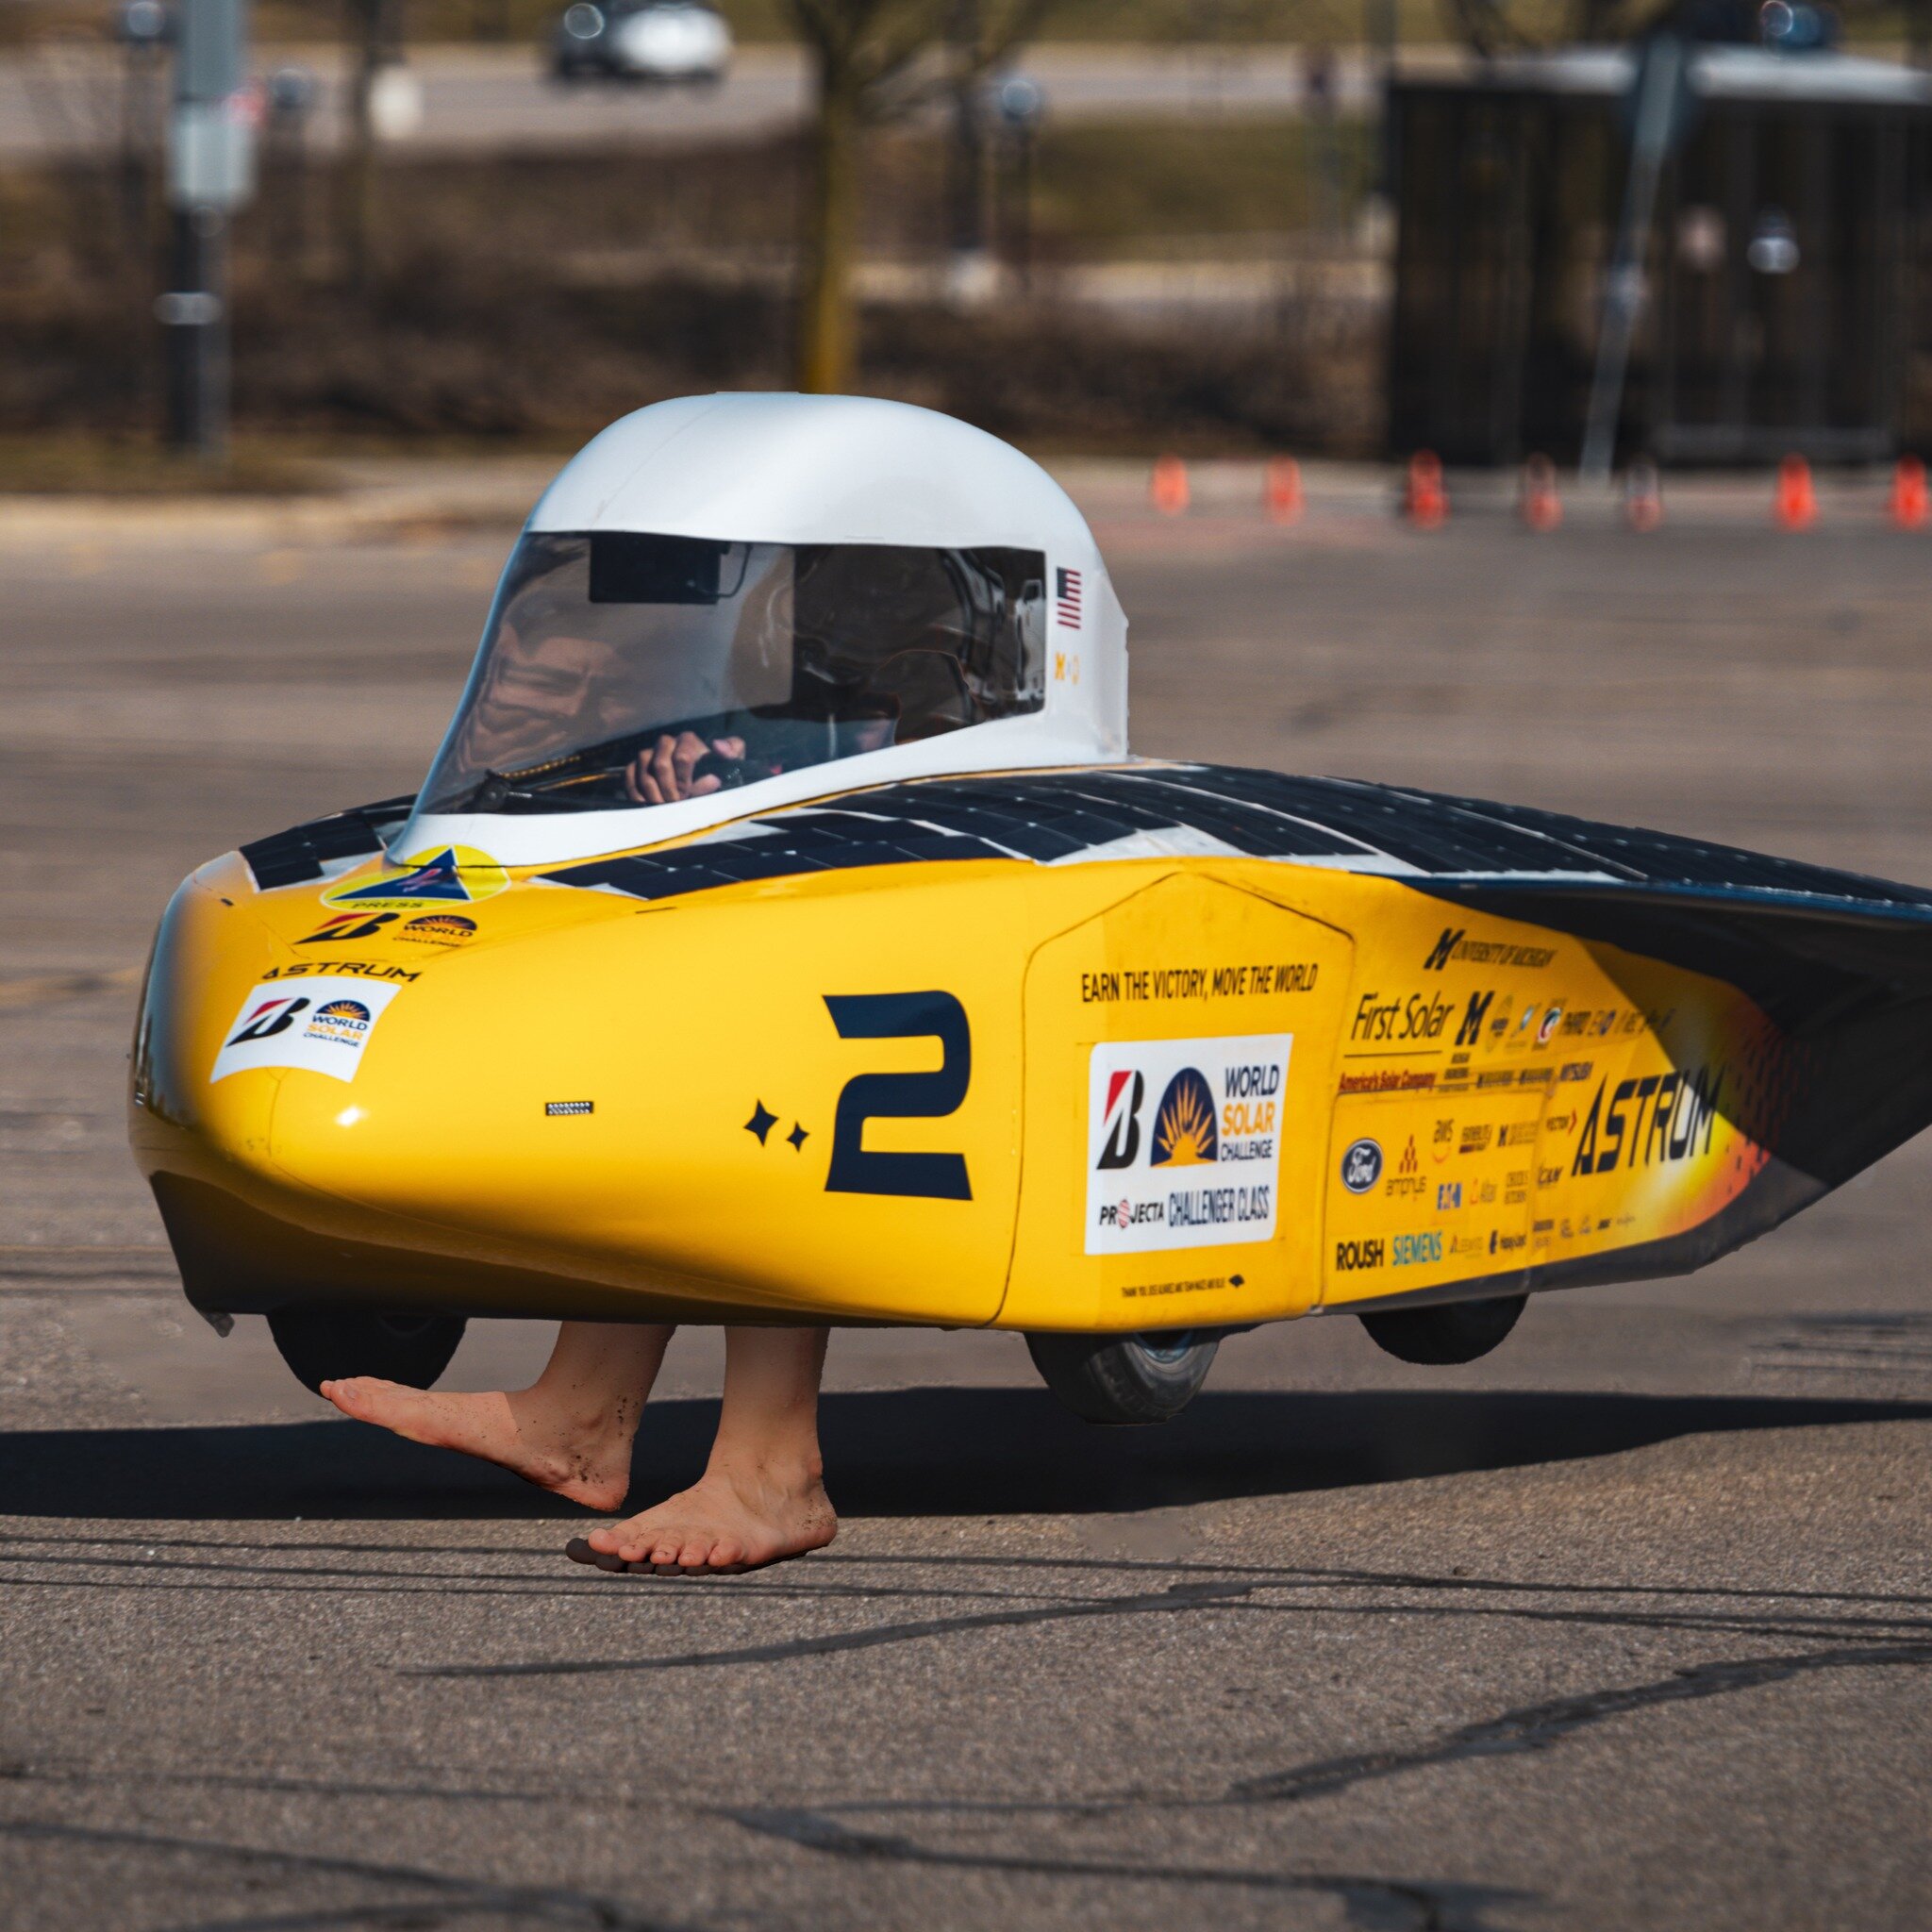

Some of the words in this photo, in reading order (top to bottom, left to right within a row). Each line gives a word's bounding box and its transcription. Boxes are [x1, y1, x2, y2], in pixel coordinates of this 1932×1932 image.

[403, 924, 474, 937] WORLD
[1424, 927, 1465, 970] M
[261, 962, 424, 983] ASTRUM
[1081, 973, 1120, 1003] EARN
[1124, 972, 1150, 1001] THE
[1154, 968, 1208, 1000] VICTORY,
[1211, 967, 1247, 995] MOVE
[1250, 965, 1273, 993] THE
[1274, 963, 1318, 992] WORLD
[308, 1024, 362, 1041] SOLAR
[312, 1014, 368, 1031] WORLD
[1351, 993, 1399, 1041] First
[1400, 991, 1454, 1038] Solar
[303, 1031, 360, 1048] CHALLENGE
[822, 990, 974, 1201] 2
[1225, 1065, 1279, 1098] WORLD
[1221, 1102, 1275, 1136] SOLAR
[1571, 1061, 1726, 1177] ASTRUM
[1221, 1139, 1273, 1162] CHALLENGE
[1347, 1147, 1376, 1182] Ford
[1168, 1188, 1235, 1227] CHALLENGER
[1238, 1185, 1270, 1222] CLASS
[1336, 1239, 1385, 1271] ROUSH
[1392, 1230, 1443, 1266] SIEMENS
